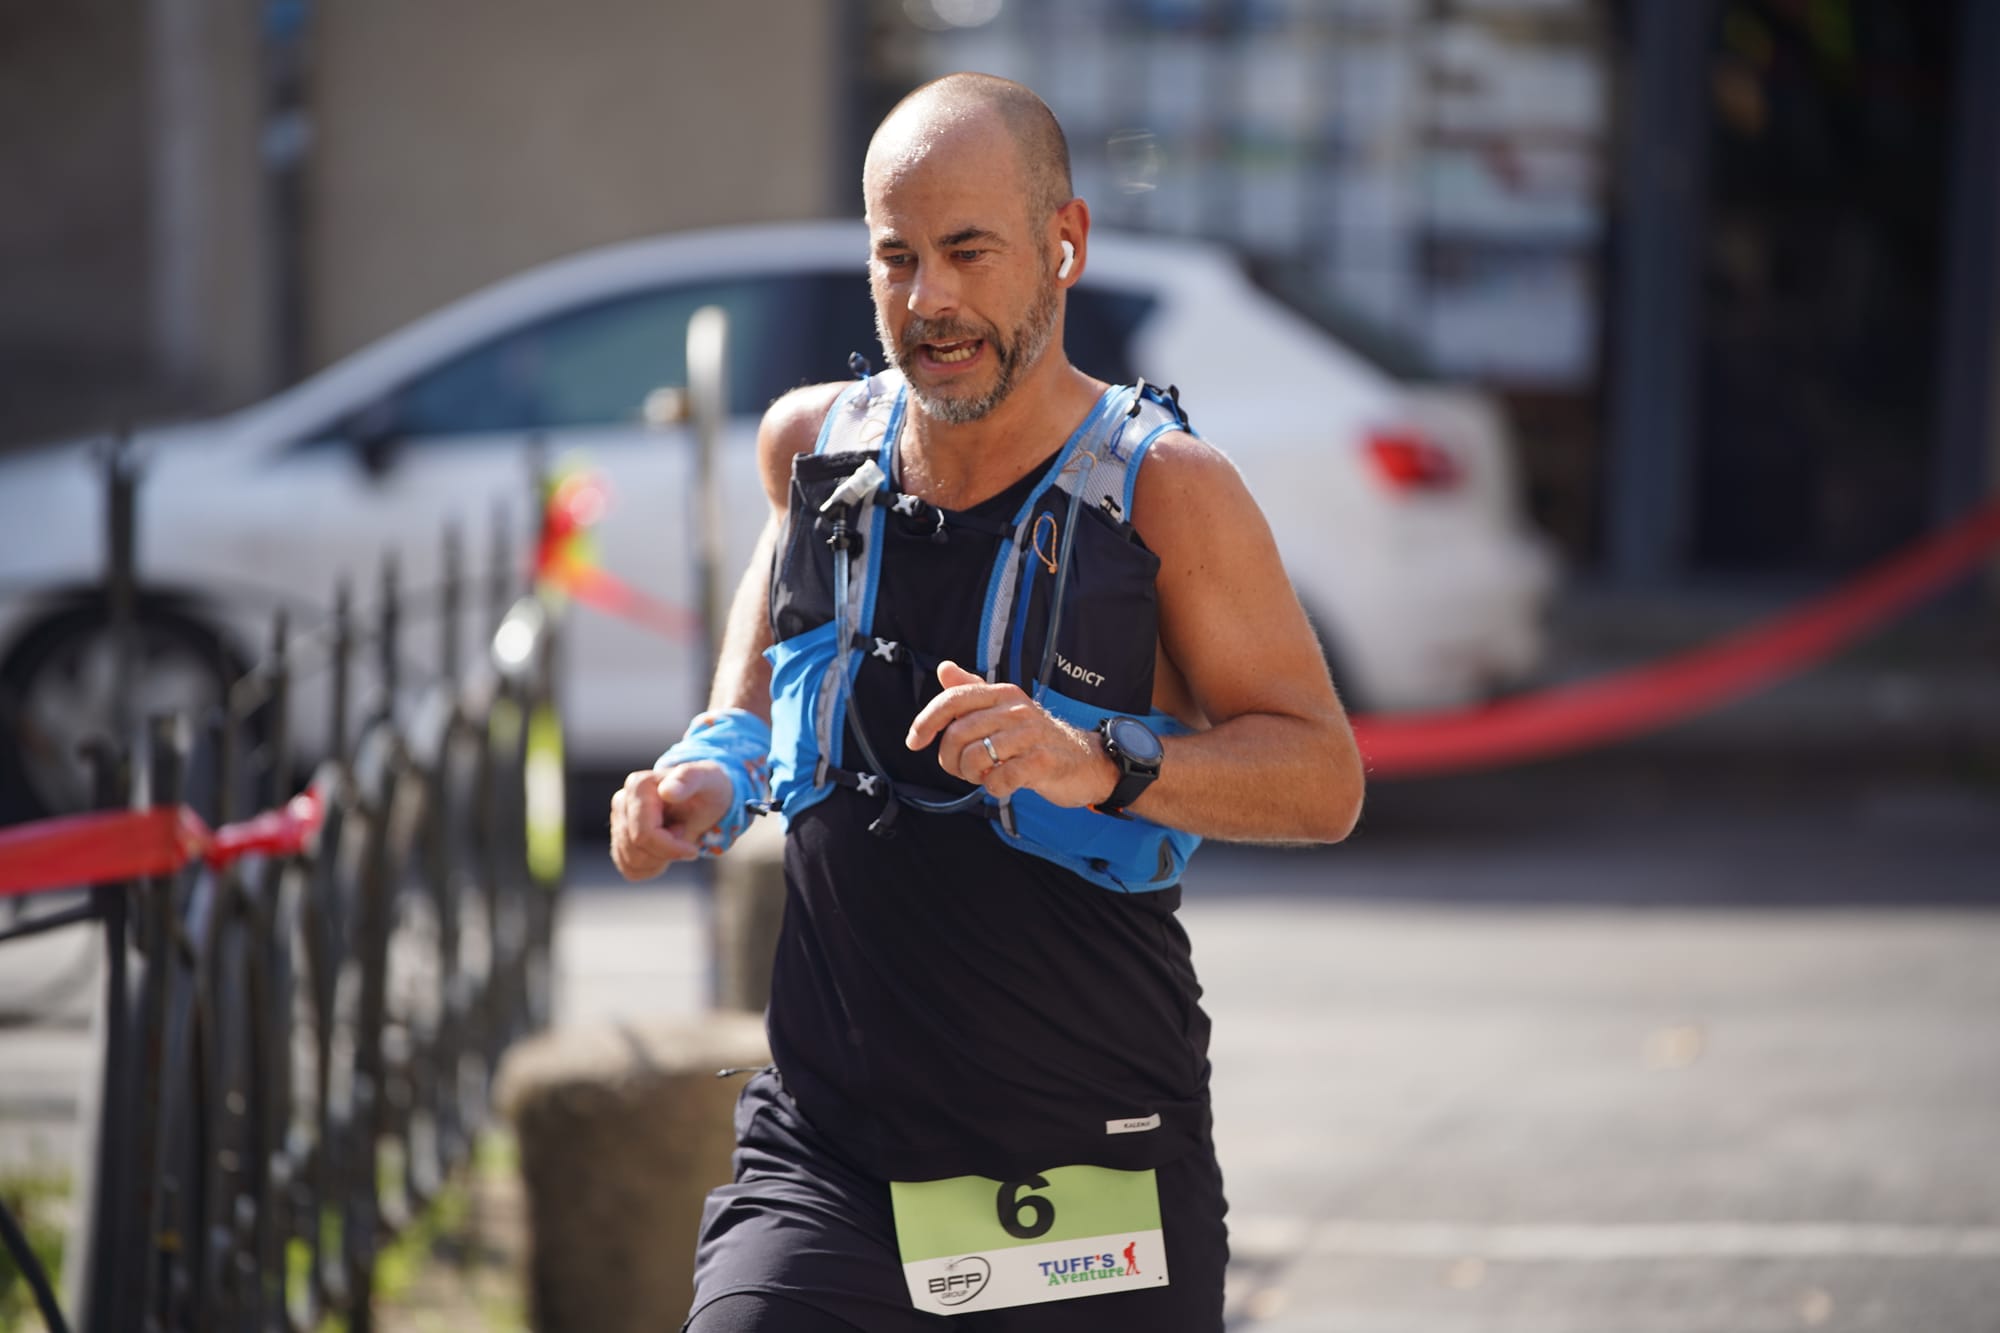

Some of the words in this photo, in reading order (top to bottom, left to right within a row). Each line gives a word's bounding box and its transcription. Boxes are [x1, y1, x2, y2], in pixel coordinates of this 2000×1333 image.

[1055, 652, 1105, 687] VADICT
[996, 1174, 1055, 1240] 6
[1038, 1254, 1115, 1277] TUFF'S
[1048, 1266, 1125, 1287] Aventure
[928, 1272, 983, 1294] BFP
[941, 1289, 968, 1300] GROUP
